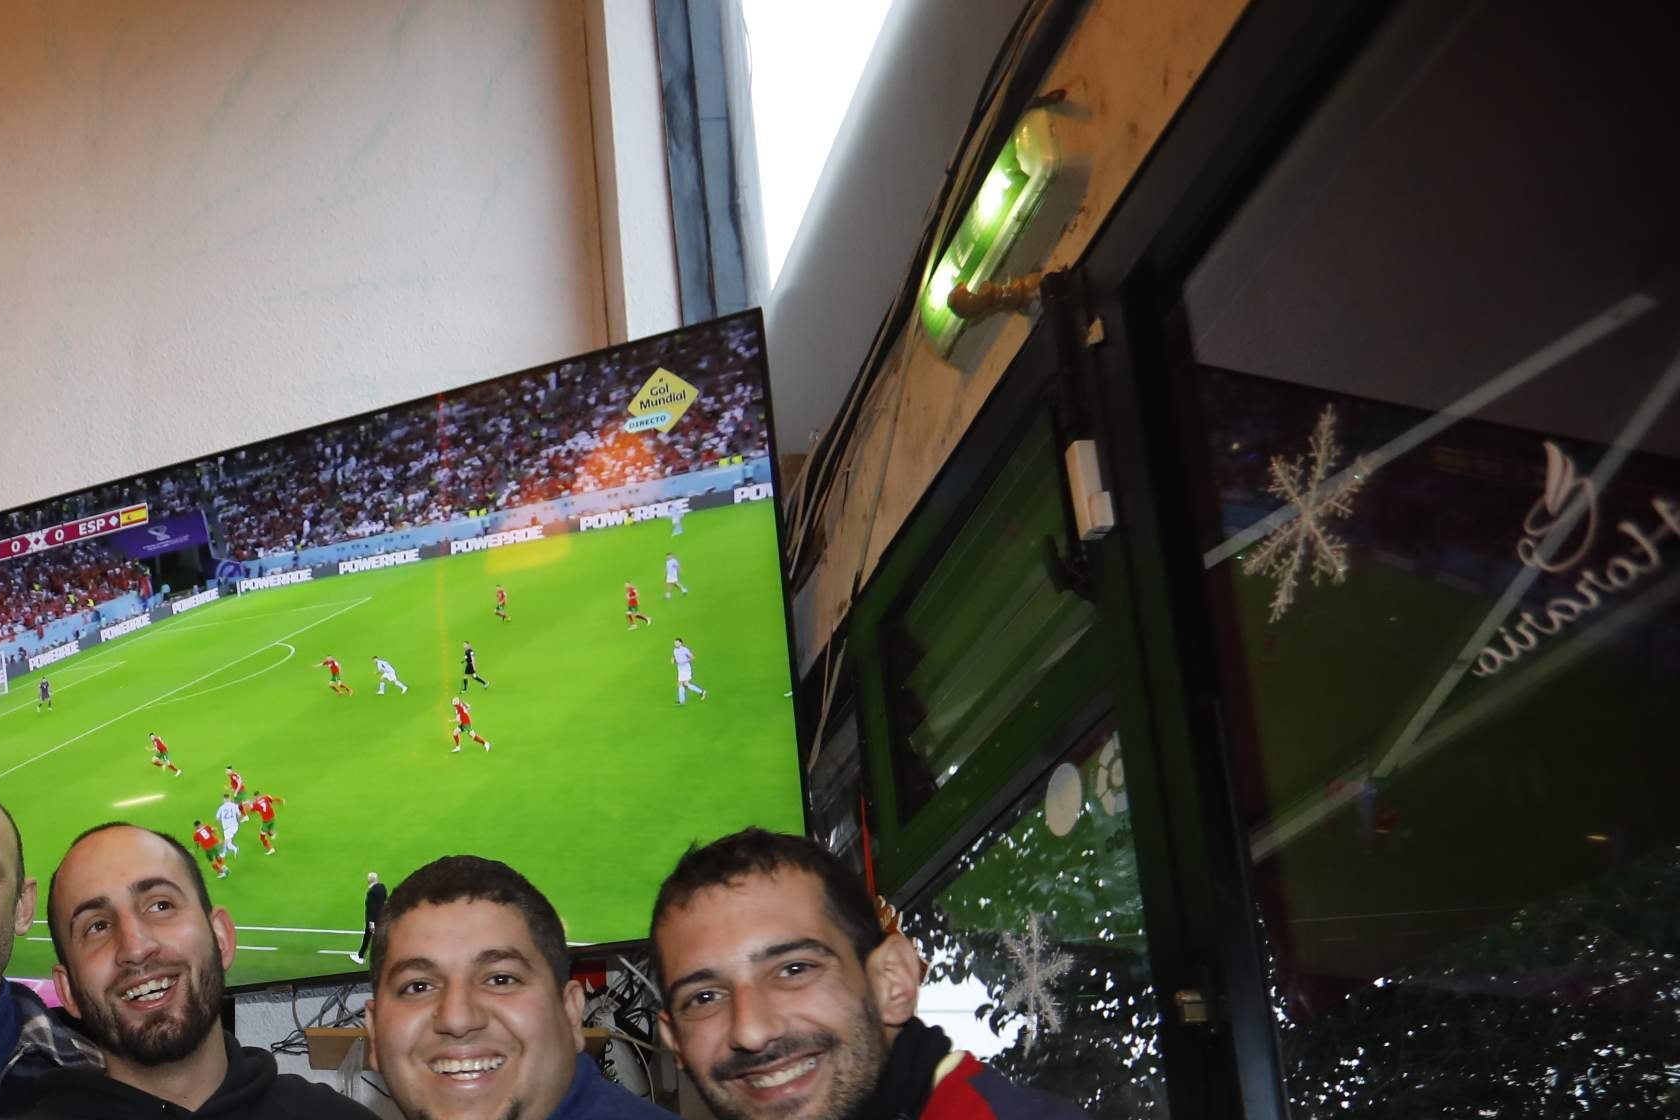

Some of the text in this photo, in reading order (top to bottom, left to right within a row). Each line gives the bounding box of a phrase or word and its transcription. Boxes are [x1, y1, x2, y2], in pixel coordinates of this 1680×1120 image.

[639, 389, 686, 410] Mundial
[650, 383, 669, 396] Gol
[629, 415, 667, 429] DIRECTO
[11, 540, 20, 553] 0
[54, 529, 64, 542] 0
[78, 518, 106, 536] ESP
[338, 548, 422, 575] POWERADE
[240, 568, 313, 593] POWERADE
